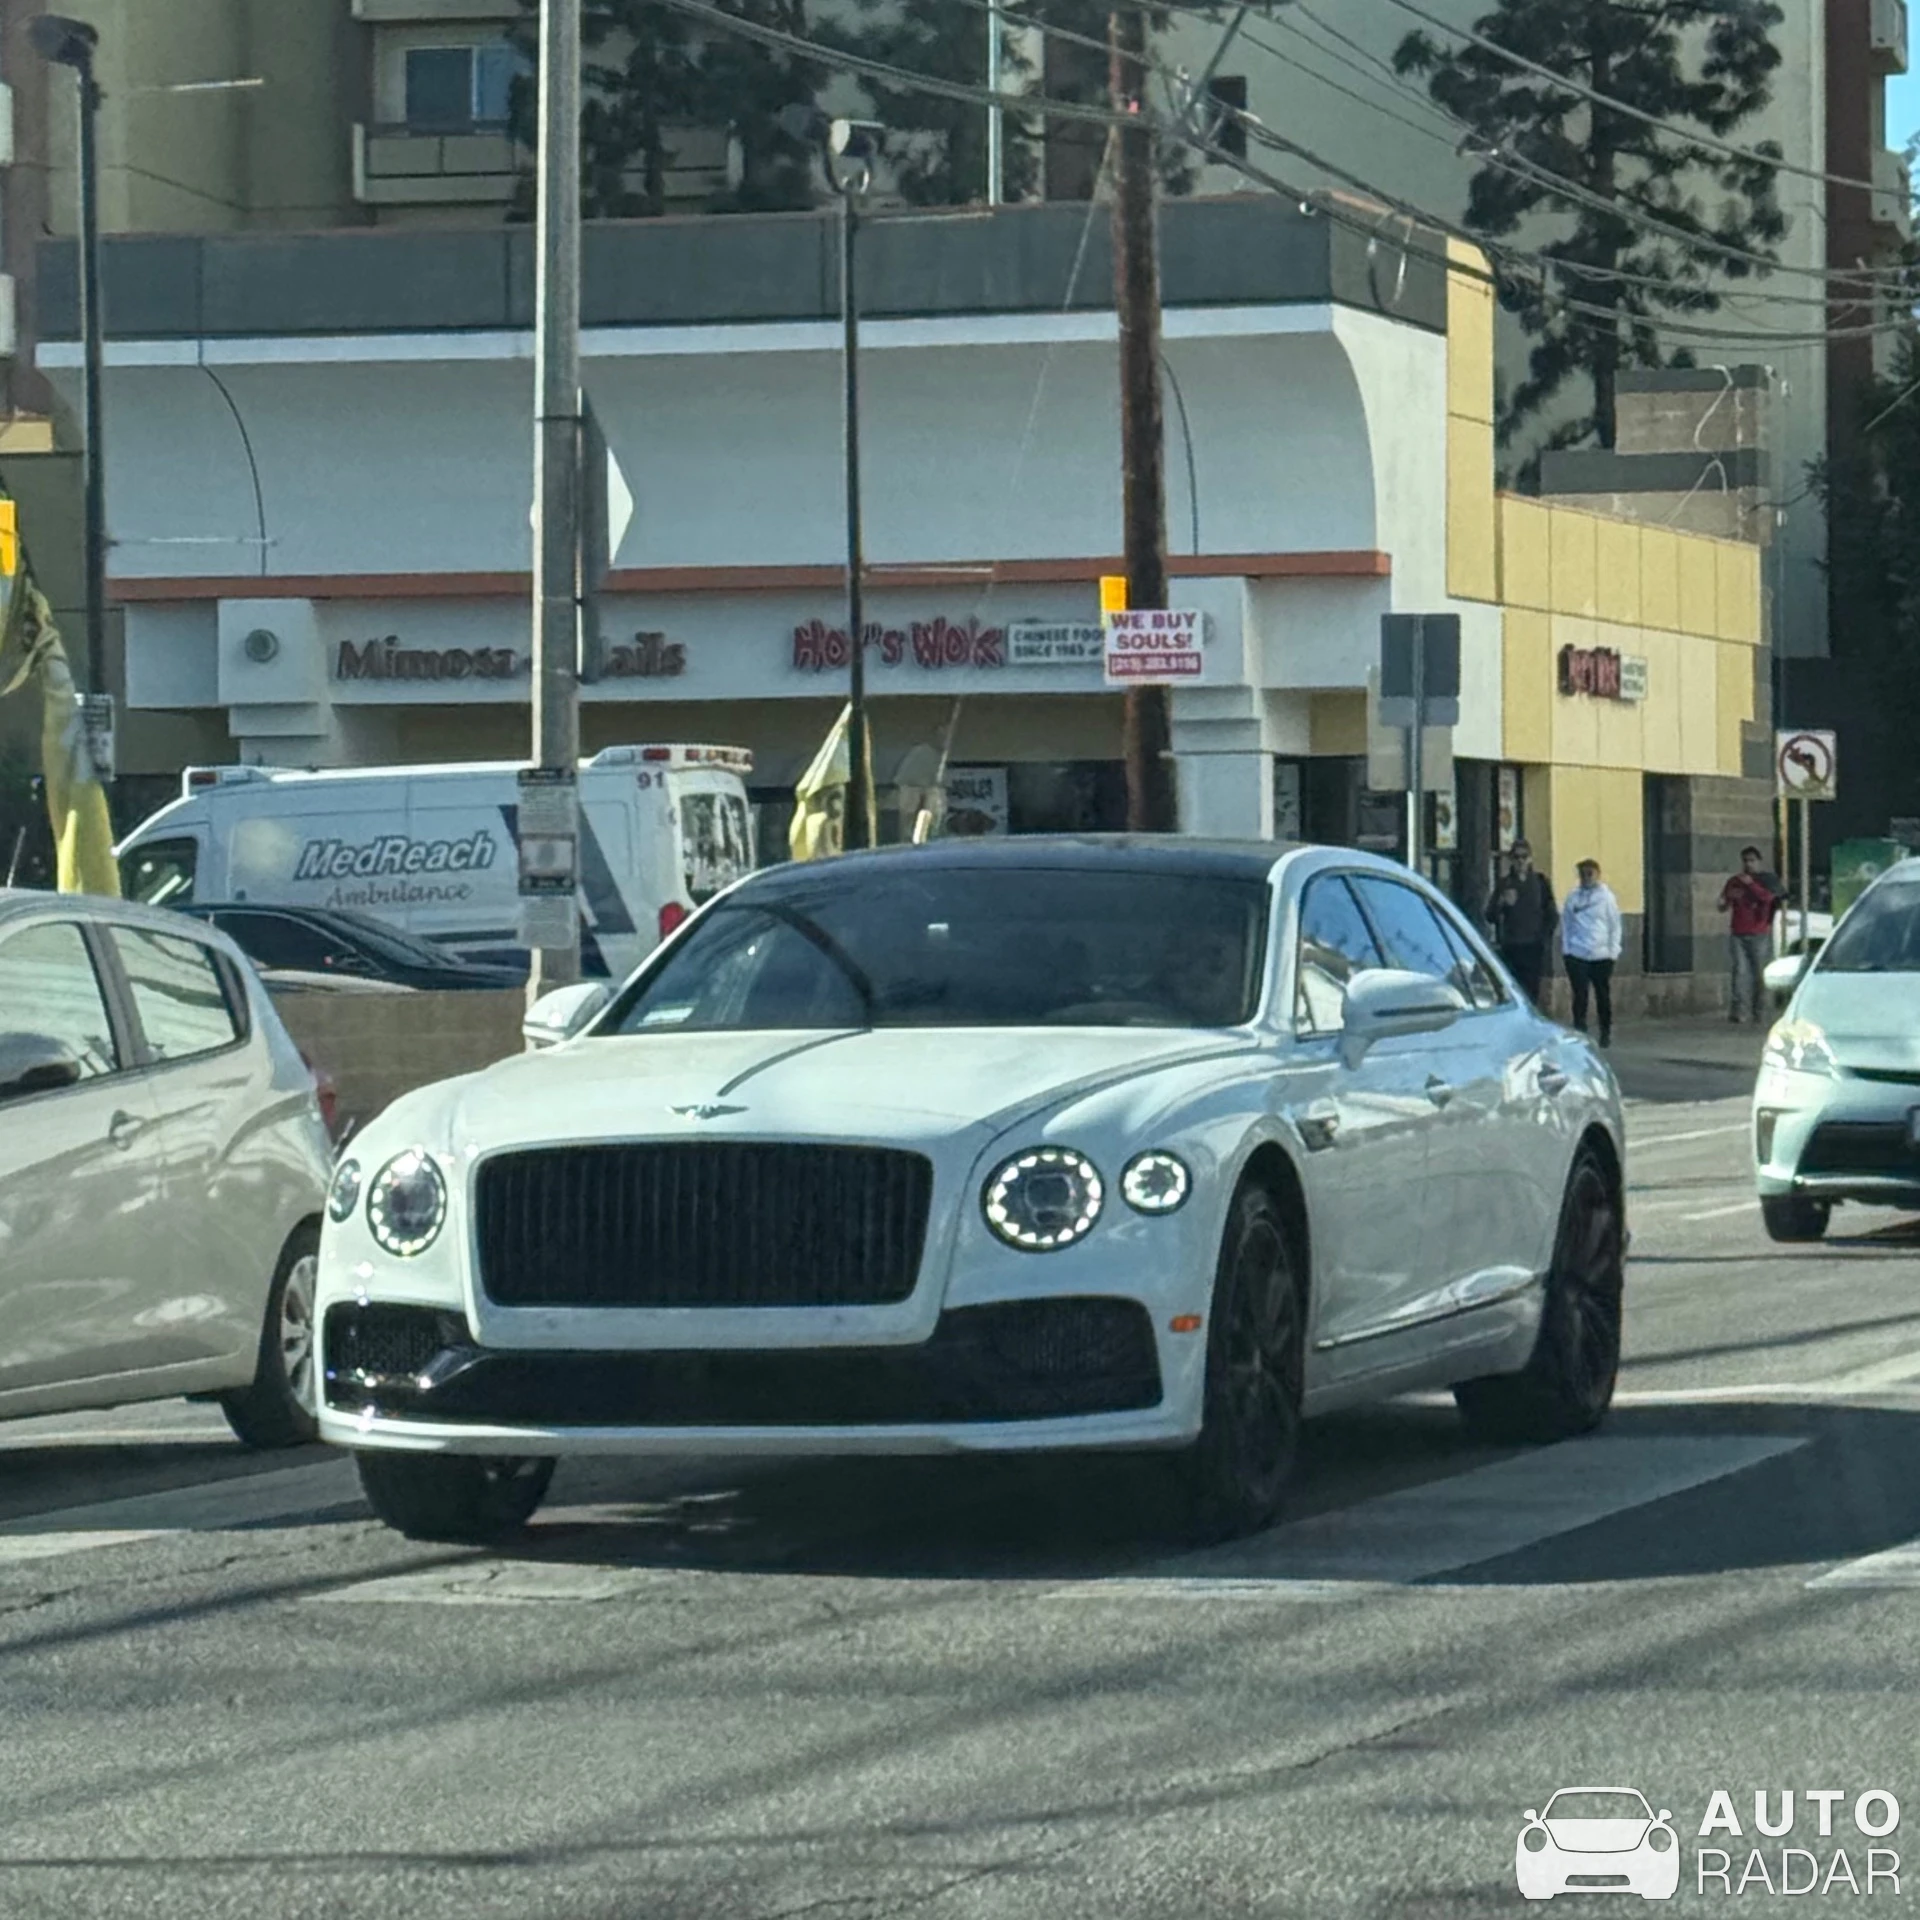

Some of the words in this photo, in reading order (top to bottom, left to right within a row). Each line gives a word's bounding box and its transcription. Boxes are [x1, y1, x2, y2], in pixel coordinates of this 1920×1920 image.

[1110, 613, 1145, 629] WE
[1152, 612, 1197, 629] BUY
[1073, 628, 1105, 641] FOO
[1116, 633, 1193, 649] SOULS!
[792, 617, 904, 672] HO'S
[636, 771, 665, 790] 91
[293, 830, 497, 881] MedReach
[324, 880, 475, 907] Ambulance
